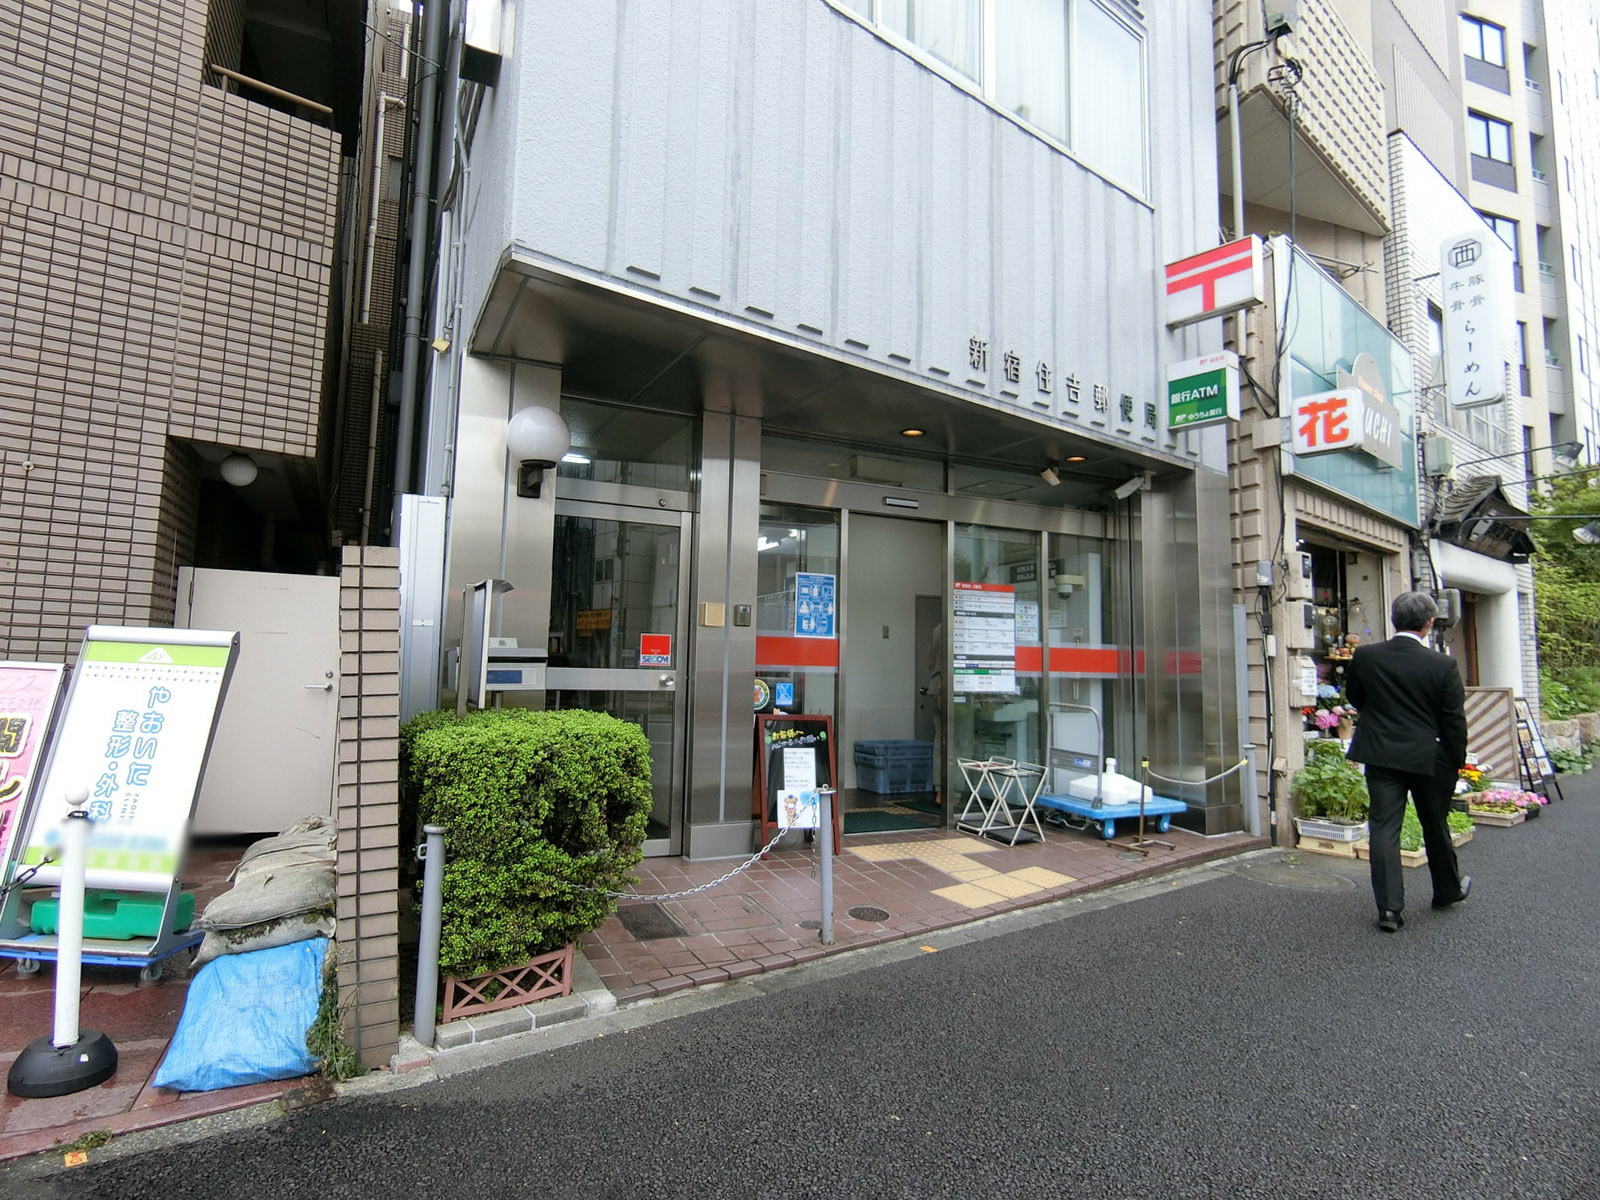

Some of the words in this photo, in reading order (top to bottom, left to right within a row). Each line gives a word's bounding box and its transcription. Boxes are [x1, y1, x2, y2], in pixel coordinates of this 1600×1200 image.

[969, 335, 1157, 430] 新宿住吉郵便局
[1171, 384, 1219, 404] 銀行ATM
[1464, 319, 1482, 397] らーめん
[1298, 397, 1349, 447] 花
[642, 655, 669, 663] SECOM
[88, 709, 139, 820] 整形・外科
[126, 686, 172, 786] やおいた
